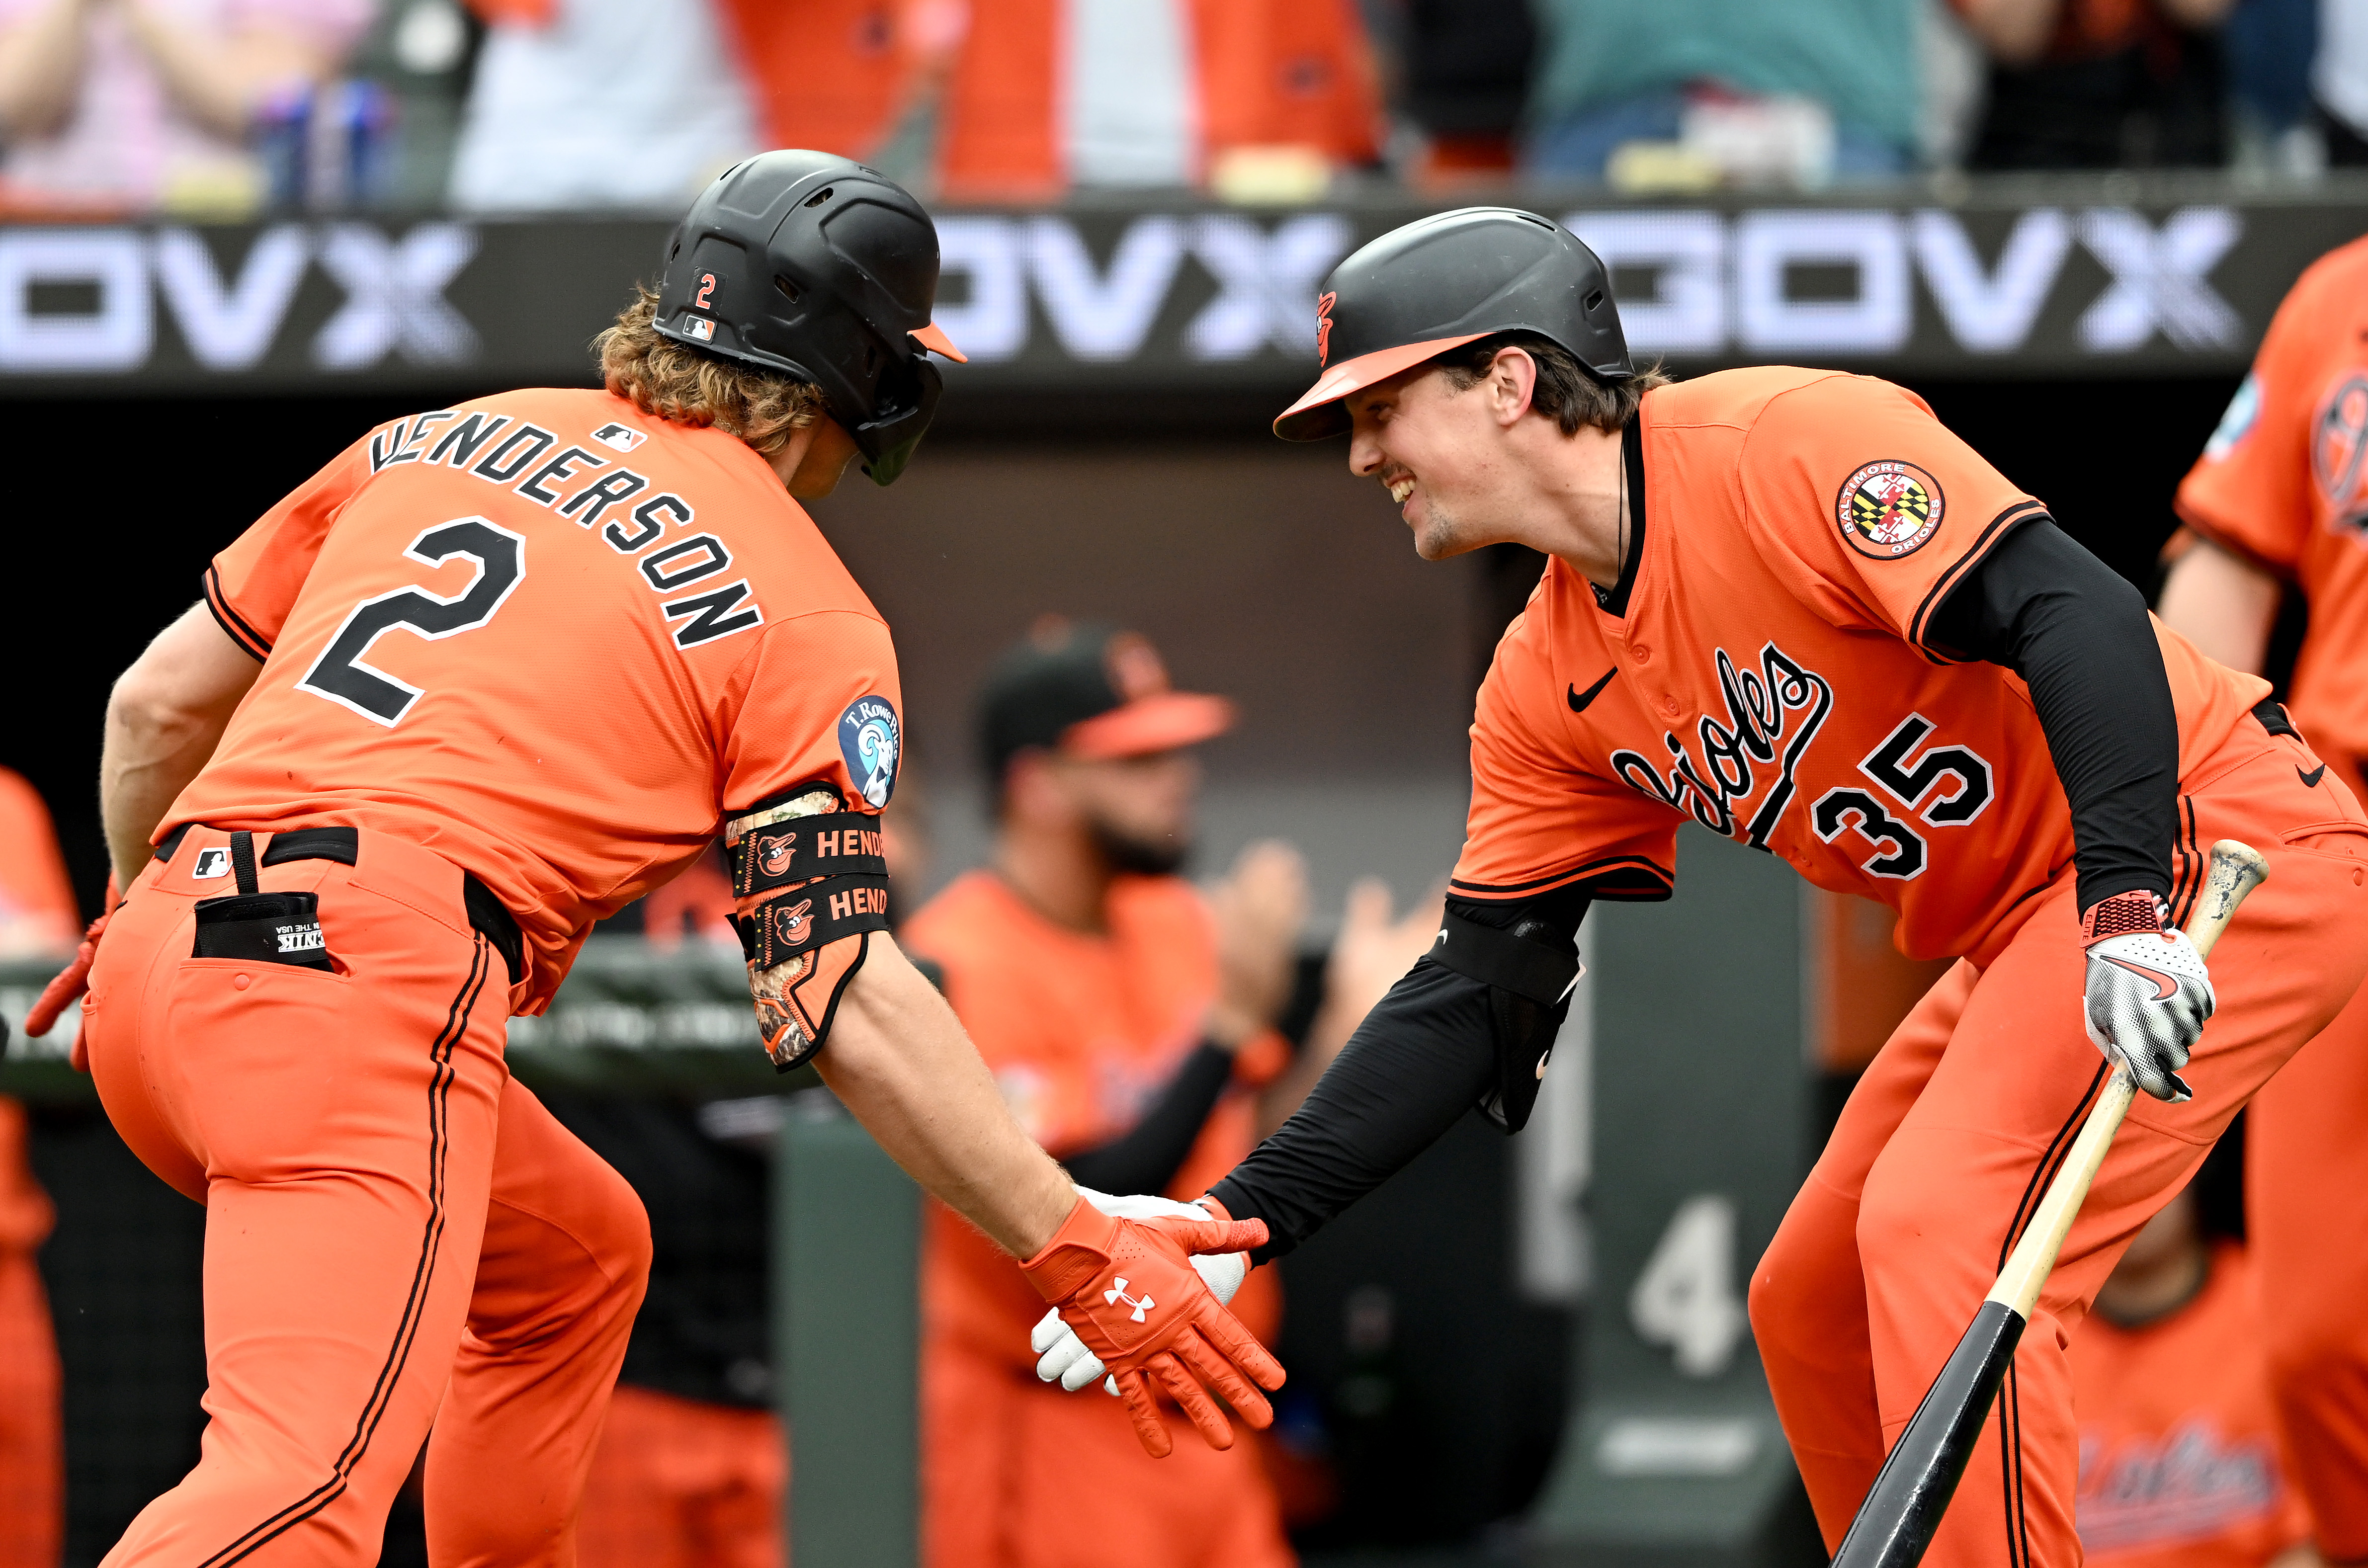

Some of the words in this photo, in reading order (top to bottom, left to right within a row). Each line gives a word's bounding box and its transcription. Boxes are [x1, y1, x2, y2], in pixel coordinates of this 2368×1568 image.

[696, 273, 716, 310] 2
[1840, 463, 1905, 534] BALTIMORE
[1891, 498, 1941, 554] ORIOLES
[369, 410, 764, 652] HENDERSON
[293, 515, 526, 728] 2
[1811, 712, 1994, 881] 35
[275, 925, 293, 934] USA
[295, 924, 312, 932] THE
[2082, 914, 2092, 941] ELITE
[1630, 1194, 1747, 1376] 4
